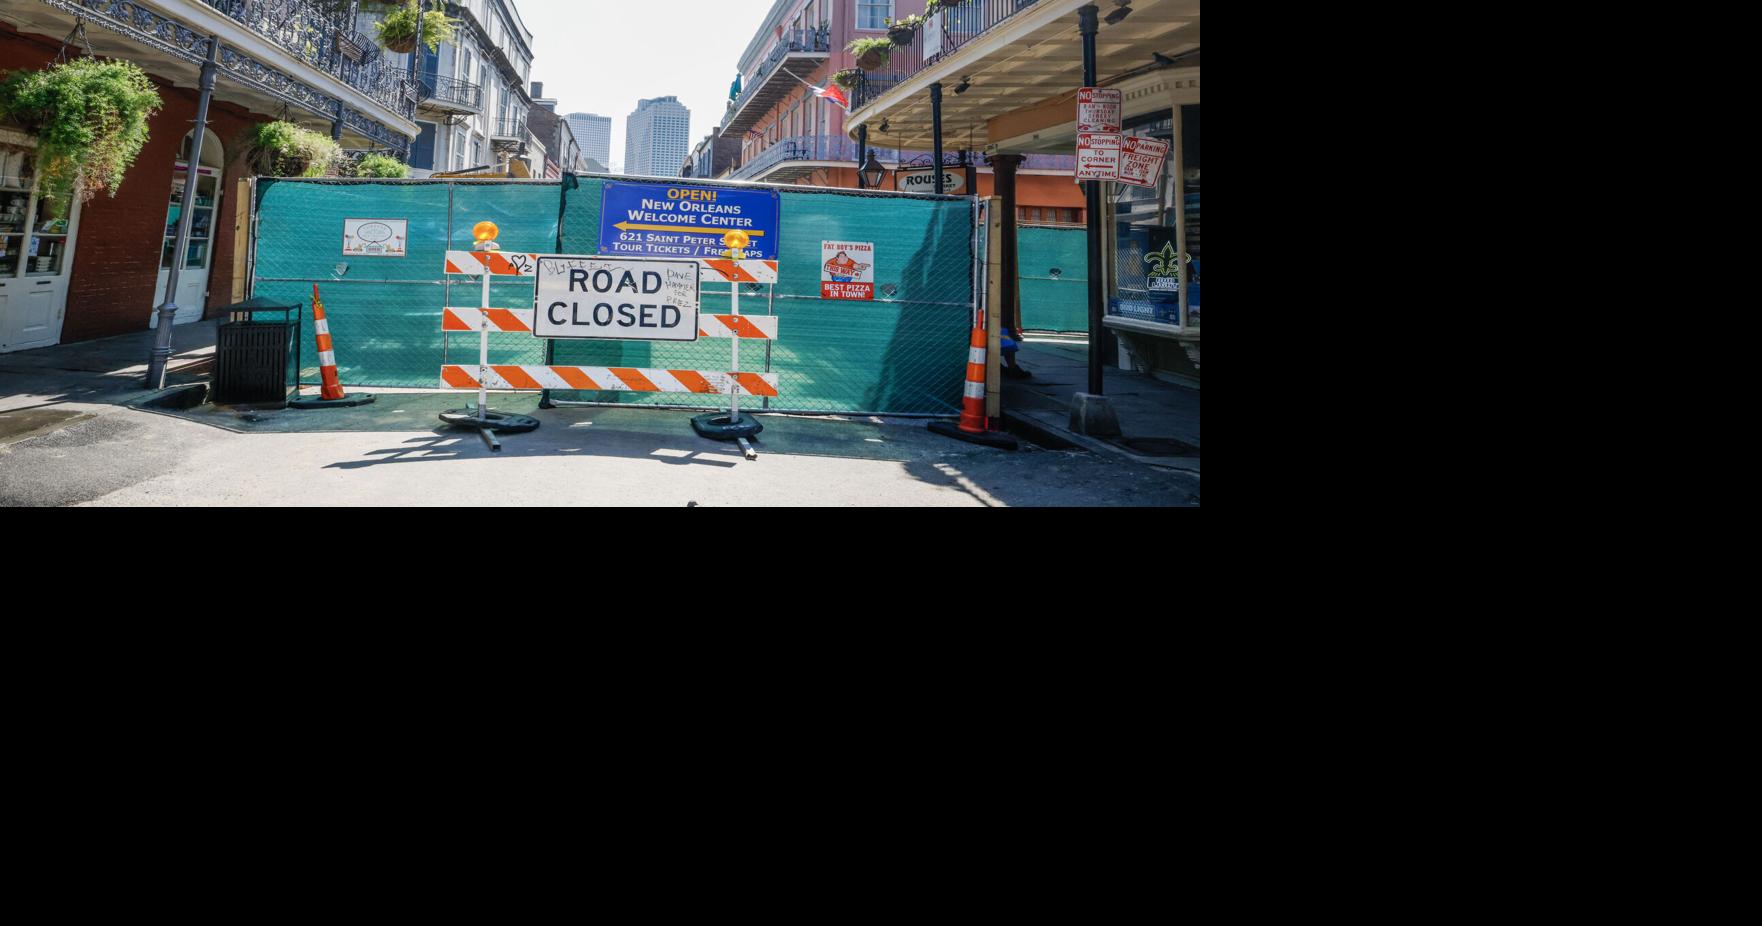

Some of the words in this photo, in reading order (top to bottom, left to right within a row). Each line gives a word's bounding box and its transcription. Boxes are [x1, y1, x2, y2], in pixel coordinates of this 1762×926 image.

[1079, 91, 1091, 100] NO
[1078, 137, 1090, 146] NO
[1123, 140, 1137, 149] NO
[1135, 143, 1165, 153] PARKING
[1122, 152, 1159, 164] FREIGHT
[1126, 160, 1150, 169] ZONE
[667, 188, 717, 202] OPEN!
[641, 198, 675, 211] NEW
[679, 201, 741, 214] ORLEANS
[628, 210, 697, 224] WELCOME
[701, 214, 753, 227] CENTER
[619, 232, 643, 242] 621
[646, 233, 681, 243] SAINT
[683, 235, 715, 245] PETER
[612, 242, 642, 252] TOUR
[645, 244, 690, 254] TICKETS
[704, 247, 728, 256] FRE
[569, 268, 662, 294] ROAD
[824, 283, 845, 291] BEST
[847, 284, 870, 292] PIZZA
[547, 301, 681, 328] CLOSED
